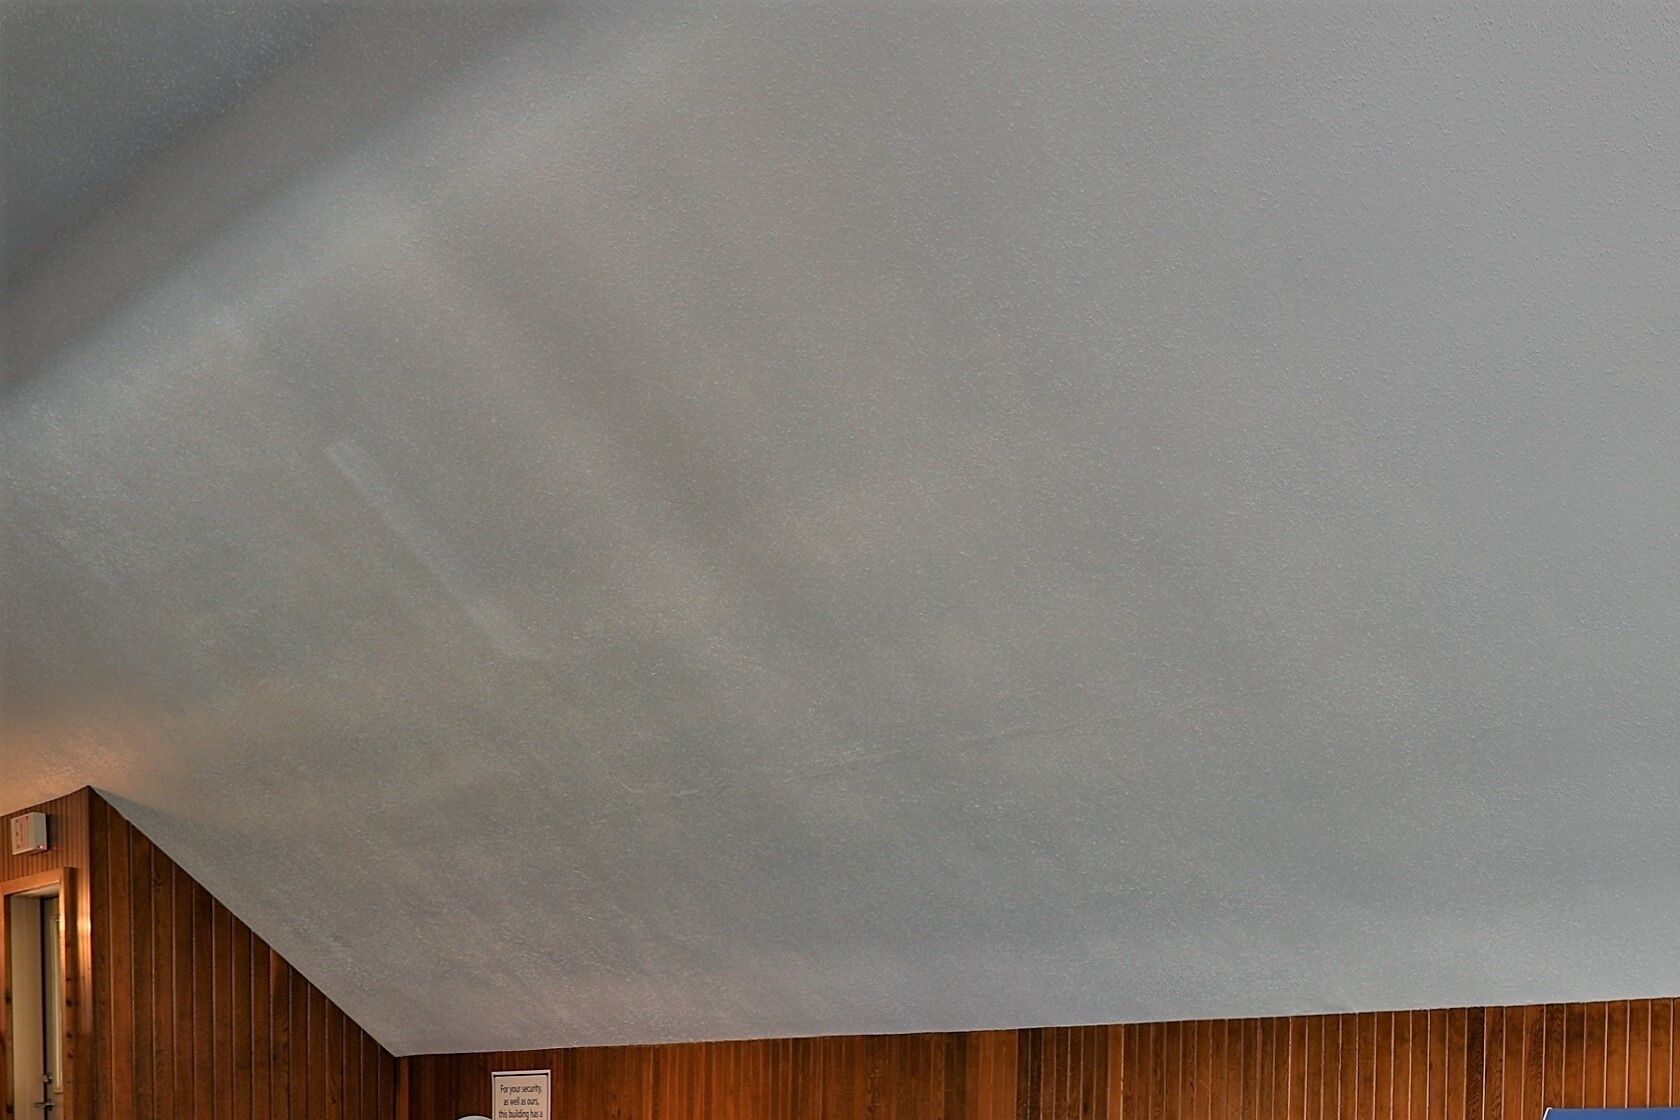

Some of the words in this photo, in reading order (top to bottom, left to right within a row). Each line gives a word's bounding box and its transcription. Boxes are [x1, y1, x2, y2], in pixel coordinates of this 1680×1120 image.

[501, 1084, 509, 1093] For
[509, 1085, 521, 1095] your
[510, 1096, 520, 1106] well
[499, 1110, 508, 1118] this
[508, 1109, 529, 1120] building
[530, 1110, 539, 1118] has
